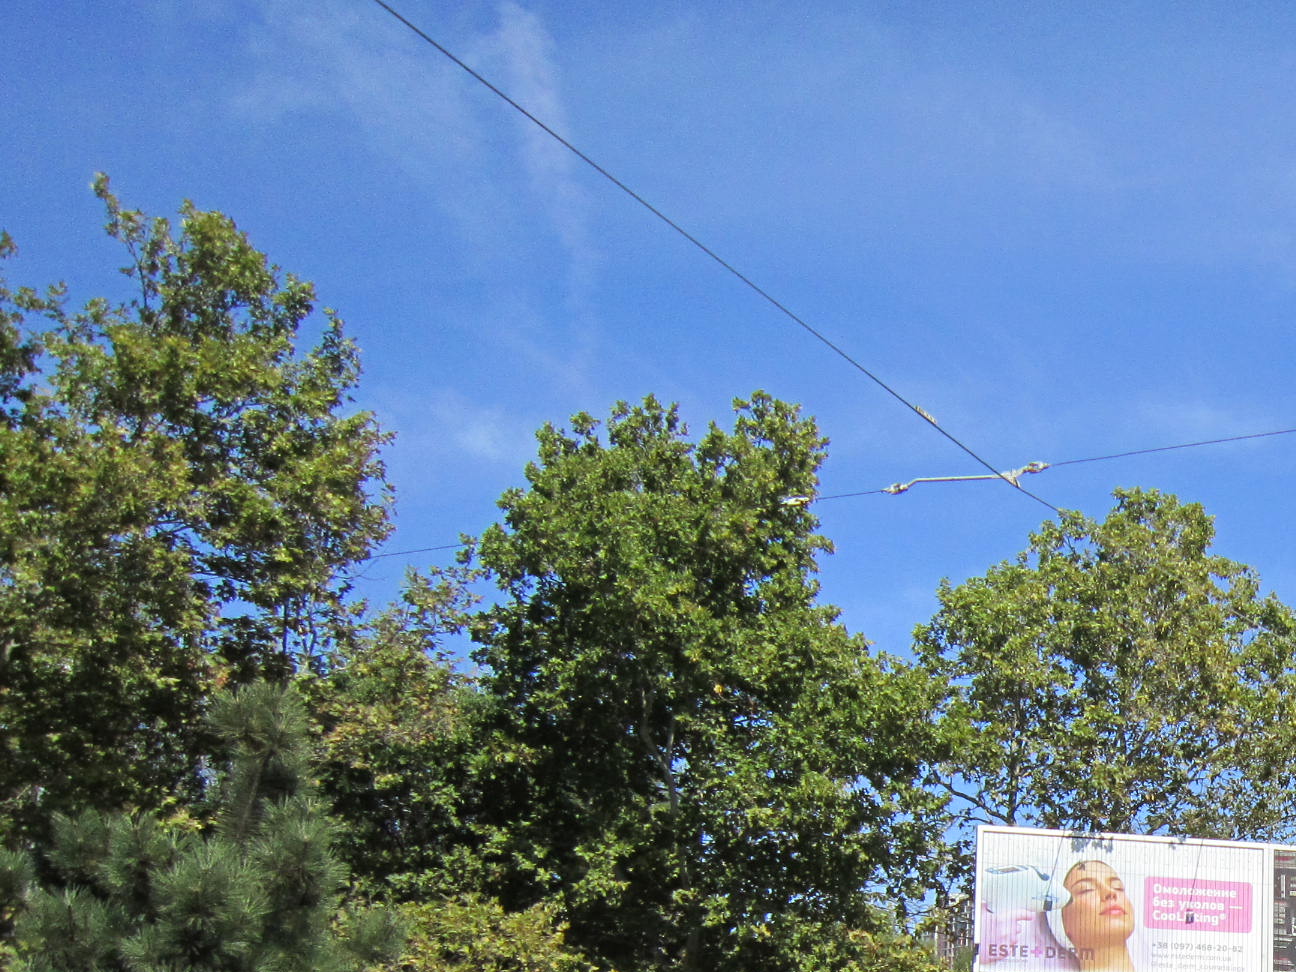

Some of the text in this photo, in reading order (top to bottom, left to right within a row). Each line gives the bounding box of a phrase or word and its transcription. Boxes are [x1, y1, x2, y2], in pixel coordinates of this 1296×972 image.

[1153, 883, 1237, 898] Омоложение
[1153, 896, 1174, 908] без
[1178, 900, 1225, 911] уколов
